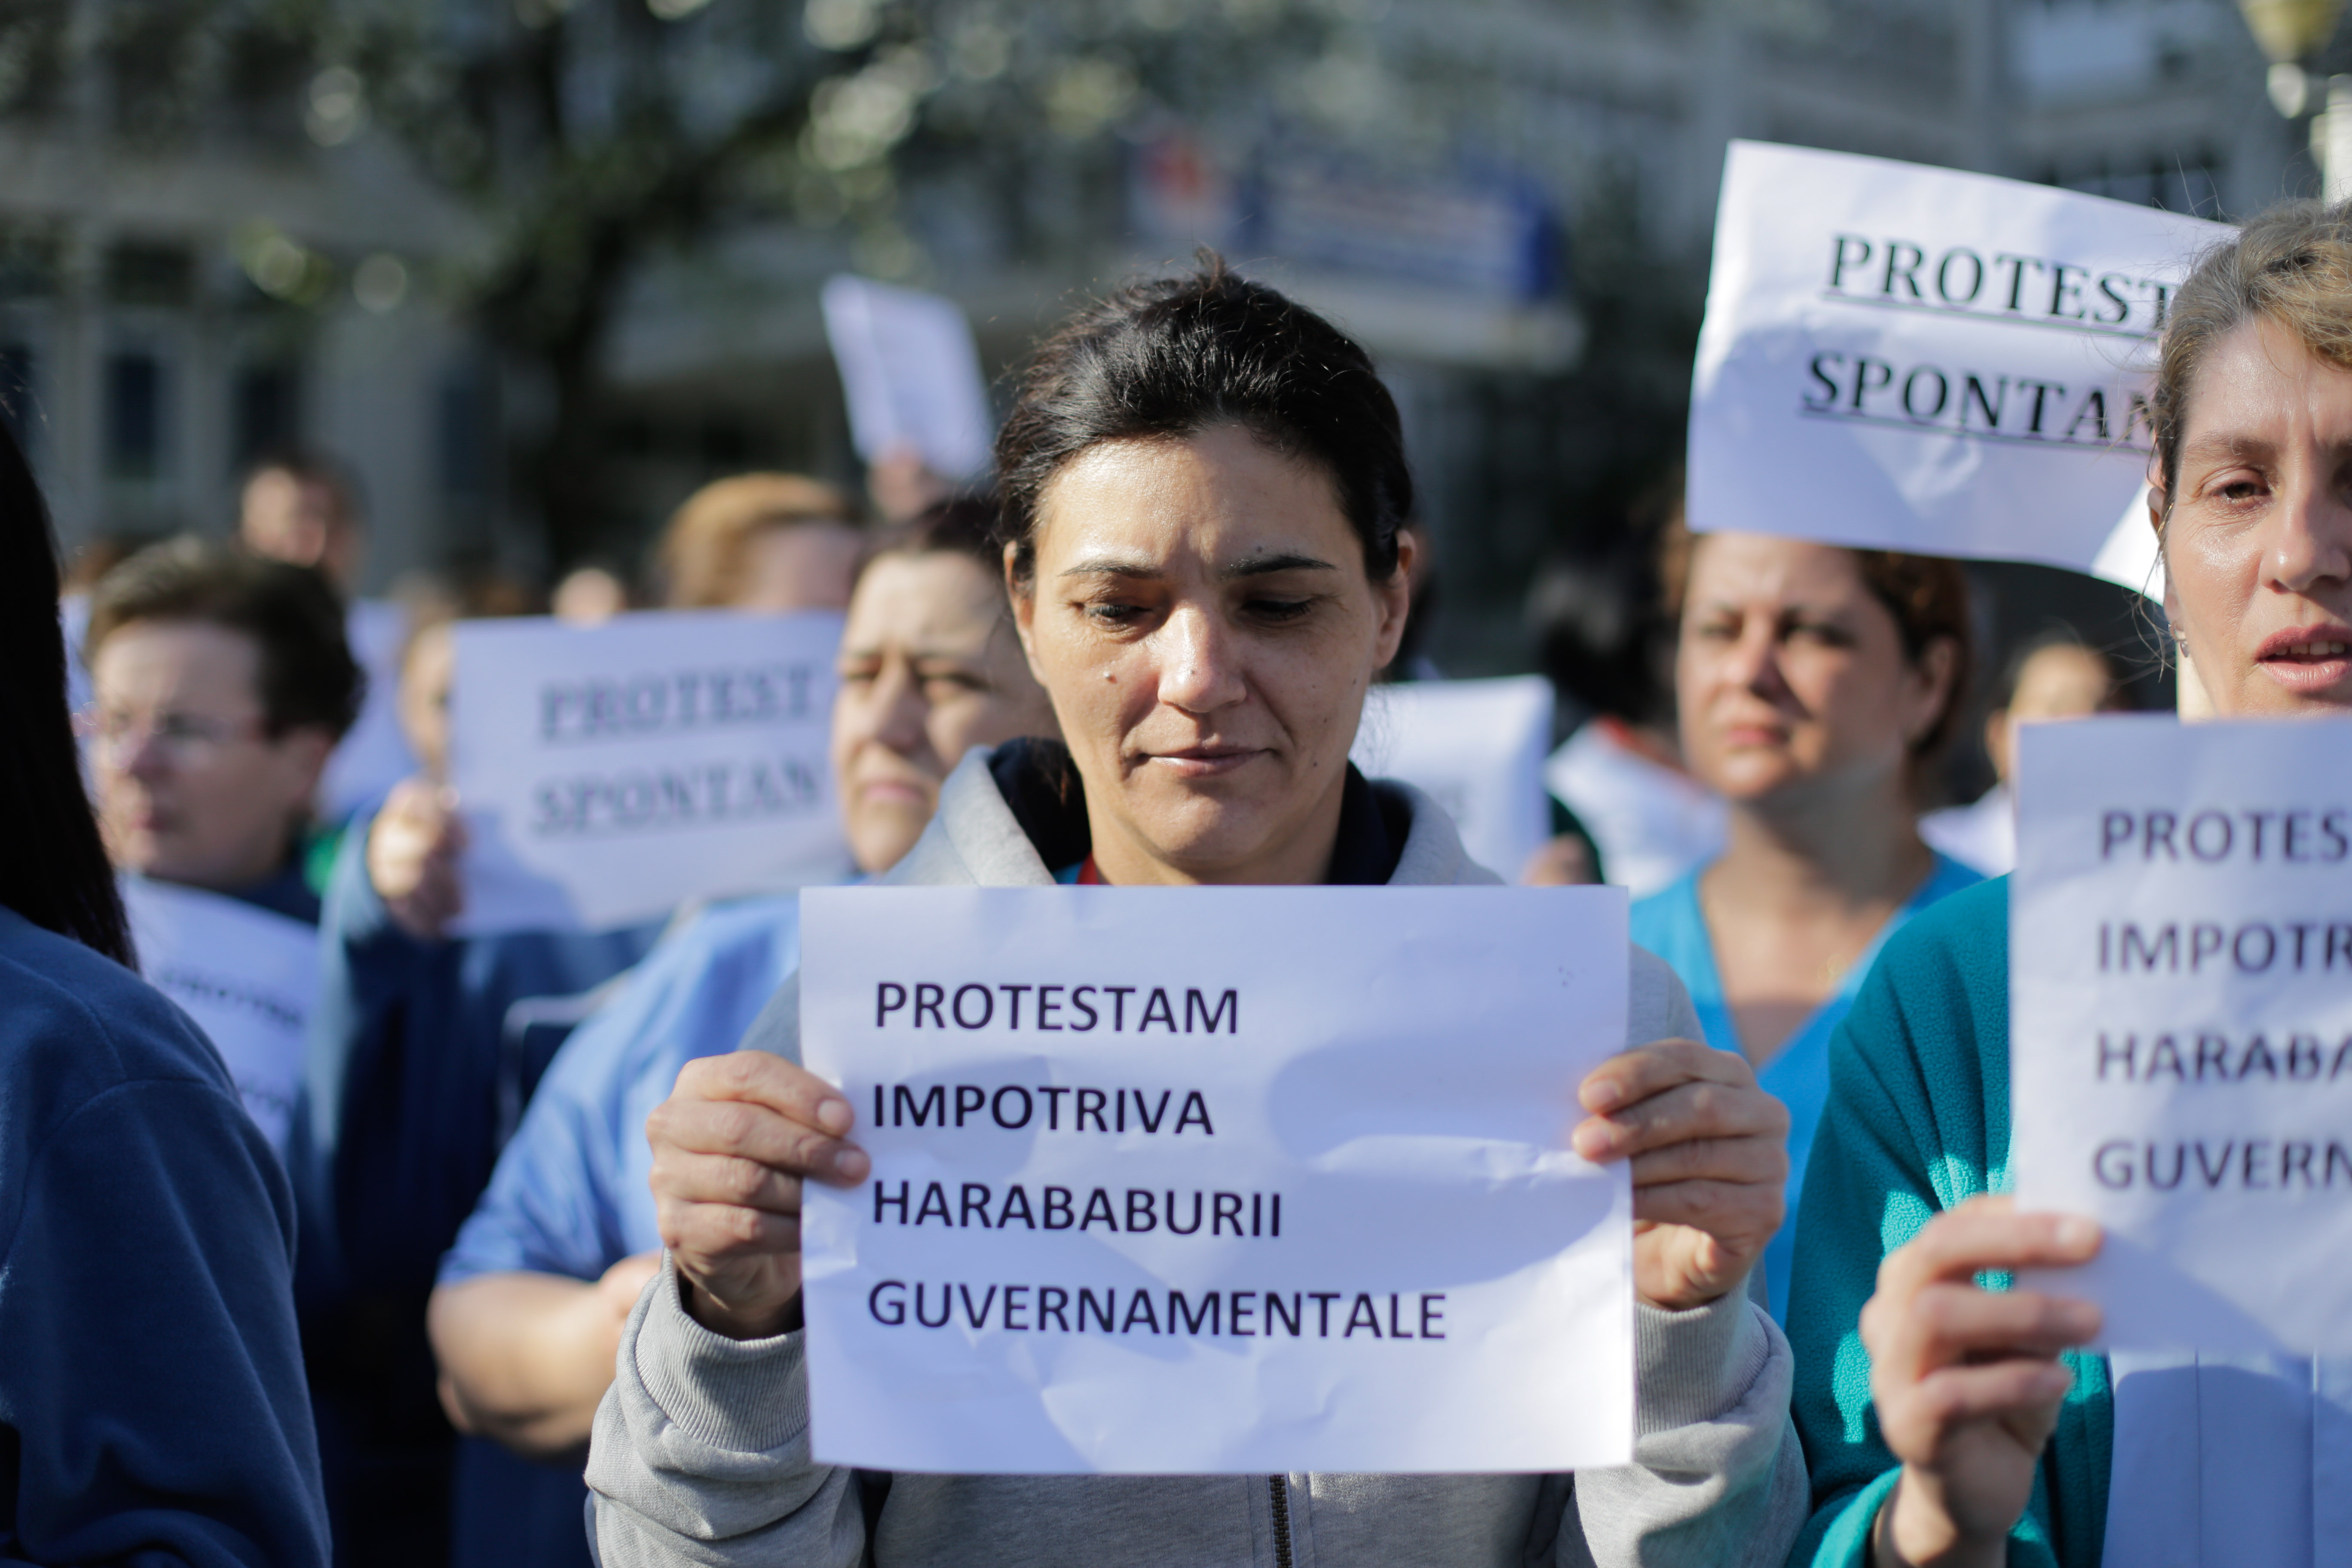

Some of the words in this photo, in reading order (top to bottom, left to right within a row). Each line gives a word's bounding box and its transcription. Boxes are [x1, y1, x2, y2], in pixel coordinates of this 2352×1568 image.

[1826, 233, 2180, 331] PROTEST
[539, 663, 812, 743] PROTEST
[533, 756, 821, 836] SPONTAN
[2100, 808, 2349, 862] PROTES
[2098, 921, 2352, 975] IMPOTR
[874, 982, 1240, 1035] PROTESTAM
[872, 1084, 1214, 1136] IMPOTRIVA
[871, 1180, 1282, 1238] HARABABURII
[868, 1280, 1447, 1340] GUVERNAMENTALE
